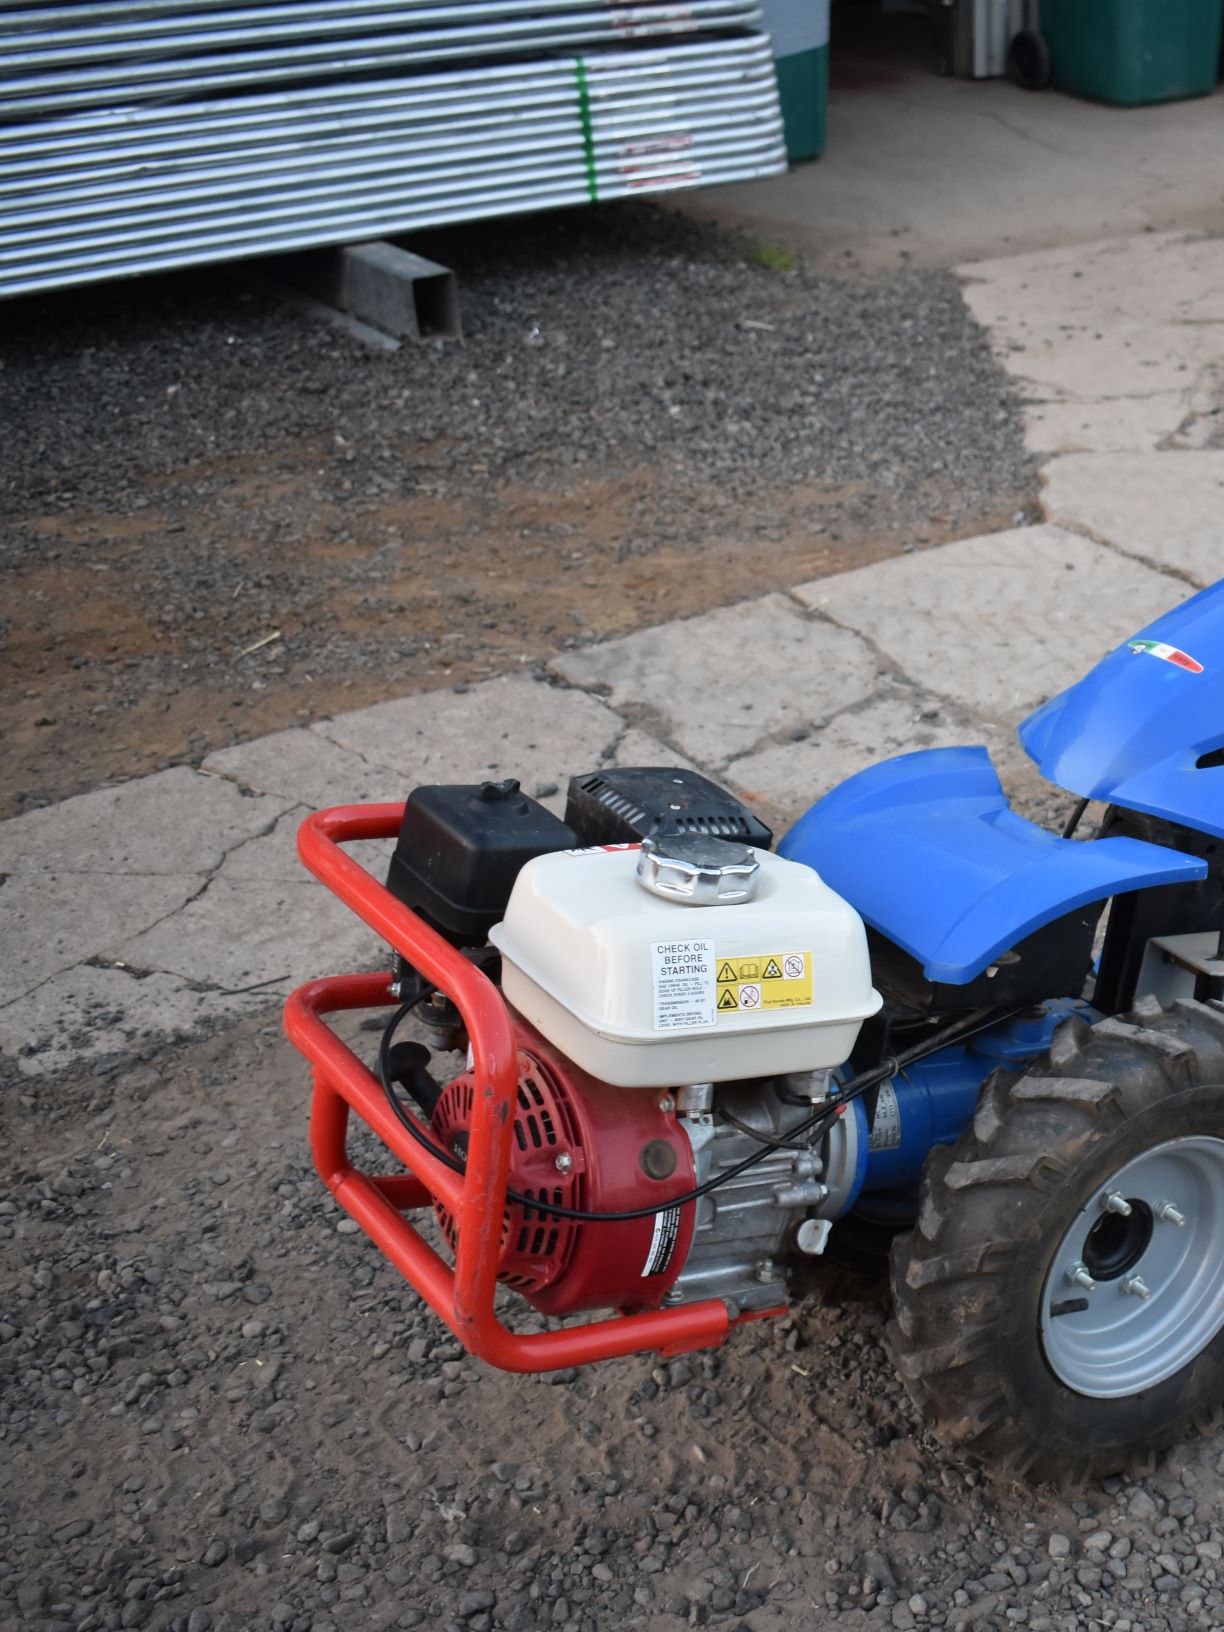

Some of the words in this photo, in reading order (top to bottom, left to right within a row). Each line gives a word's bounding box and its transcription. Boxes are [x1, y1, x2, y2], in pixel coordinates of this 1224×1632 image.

[657, 944, 691, 954] CHECK
[693, 942, 709, 952] OIL
[664, 953, 703, 965] BEFORE
[660, 964, 708, 976] STARTING
